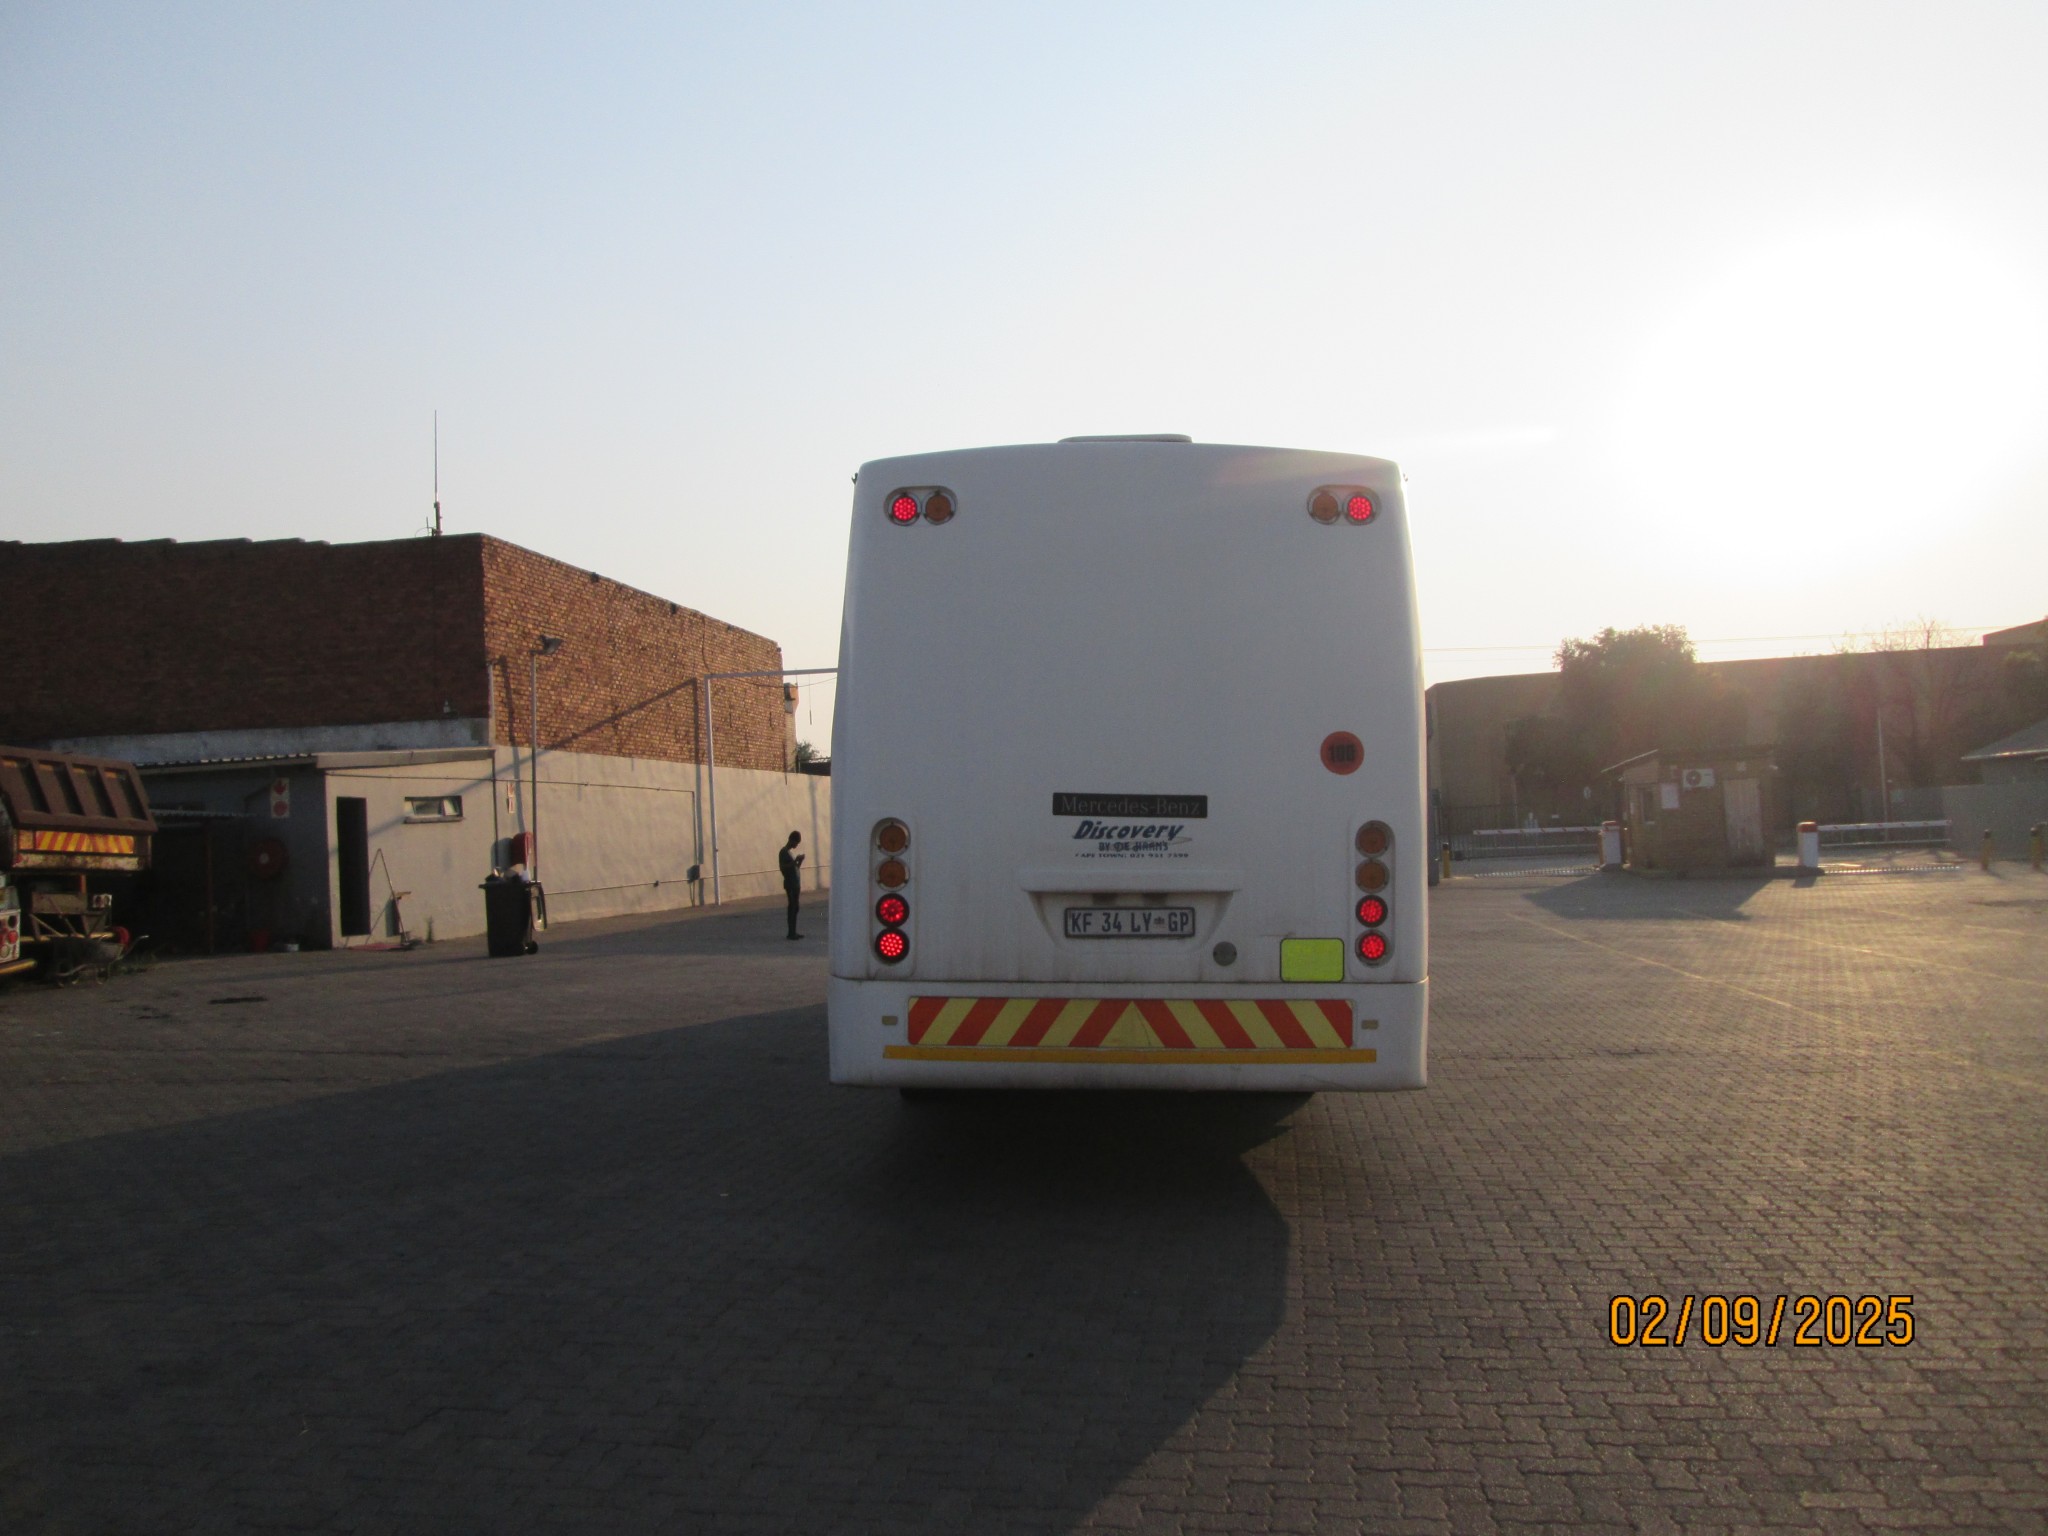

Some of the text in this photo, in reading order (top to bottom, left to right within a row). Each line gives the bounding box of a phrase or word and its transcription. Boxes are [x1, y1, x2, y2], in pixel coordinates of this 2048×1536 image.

[1061, 795, 1201, 816] Mercedes-Benz
[1073, 820, 1185, 841] Discovery
[1098, 842, 1111, 852] BY
[1071, 912, 1189, 933] KF 34 LY GP
